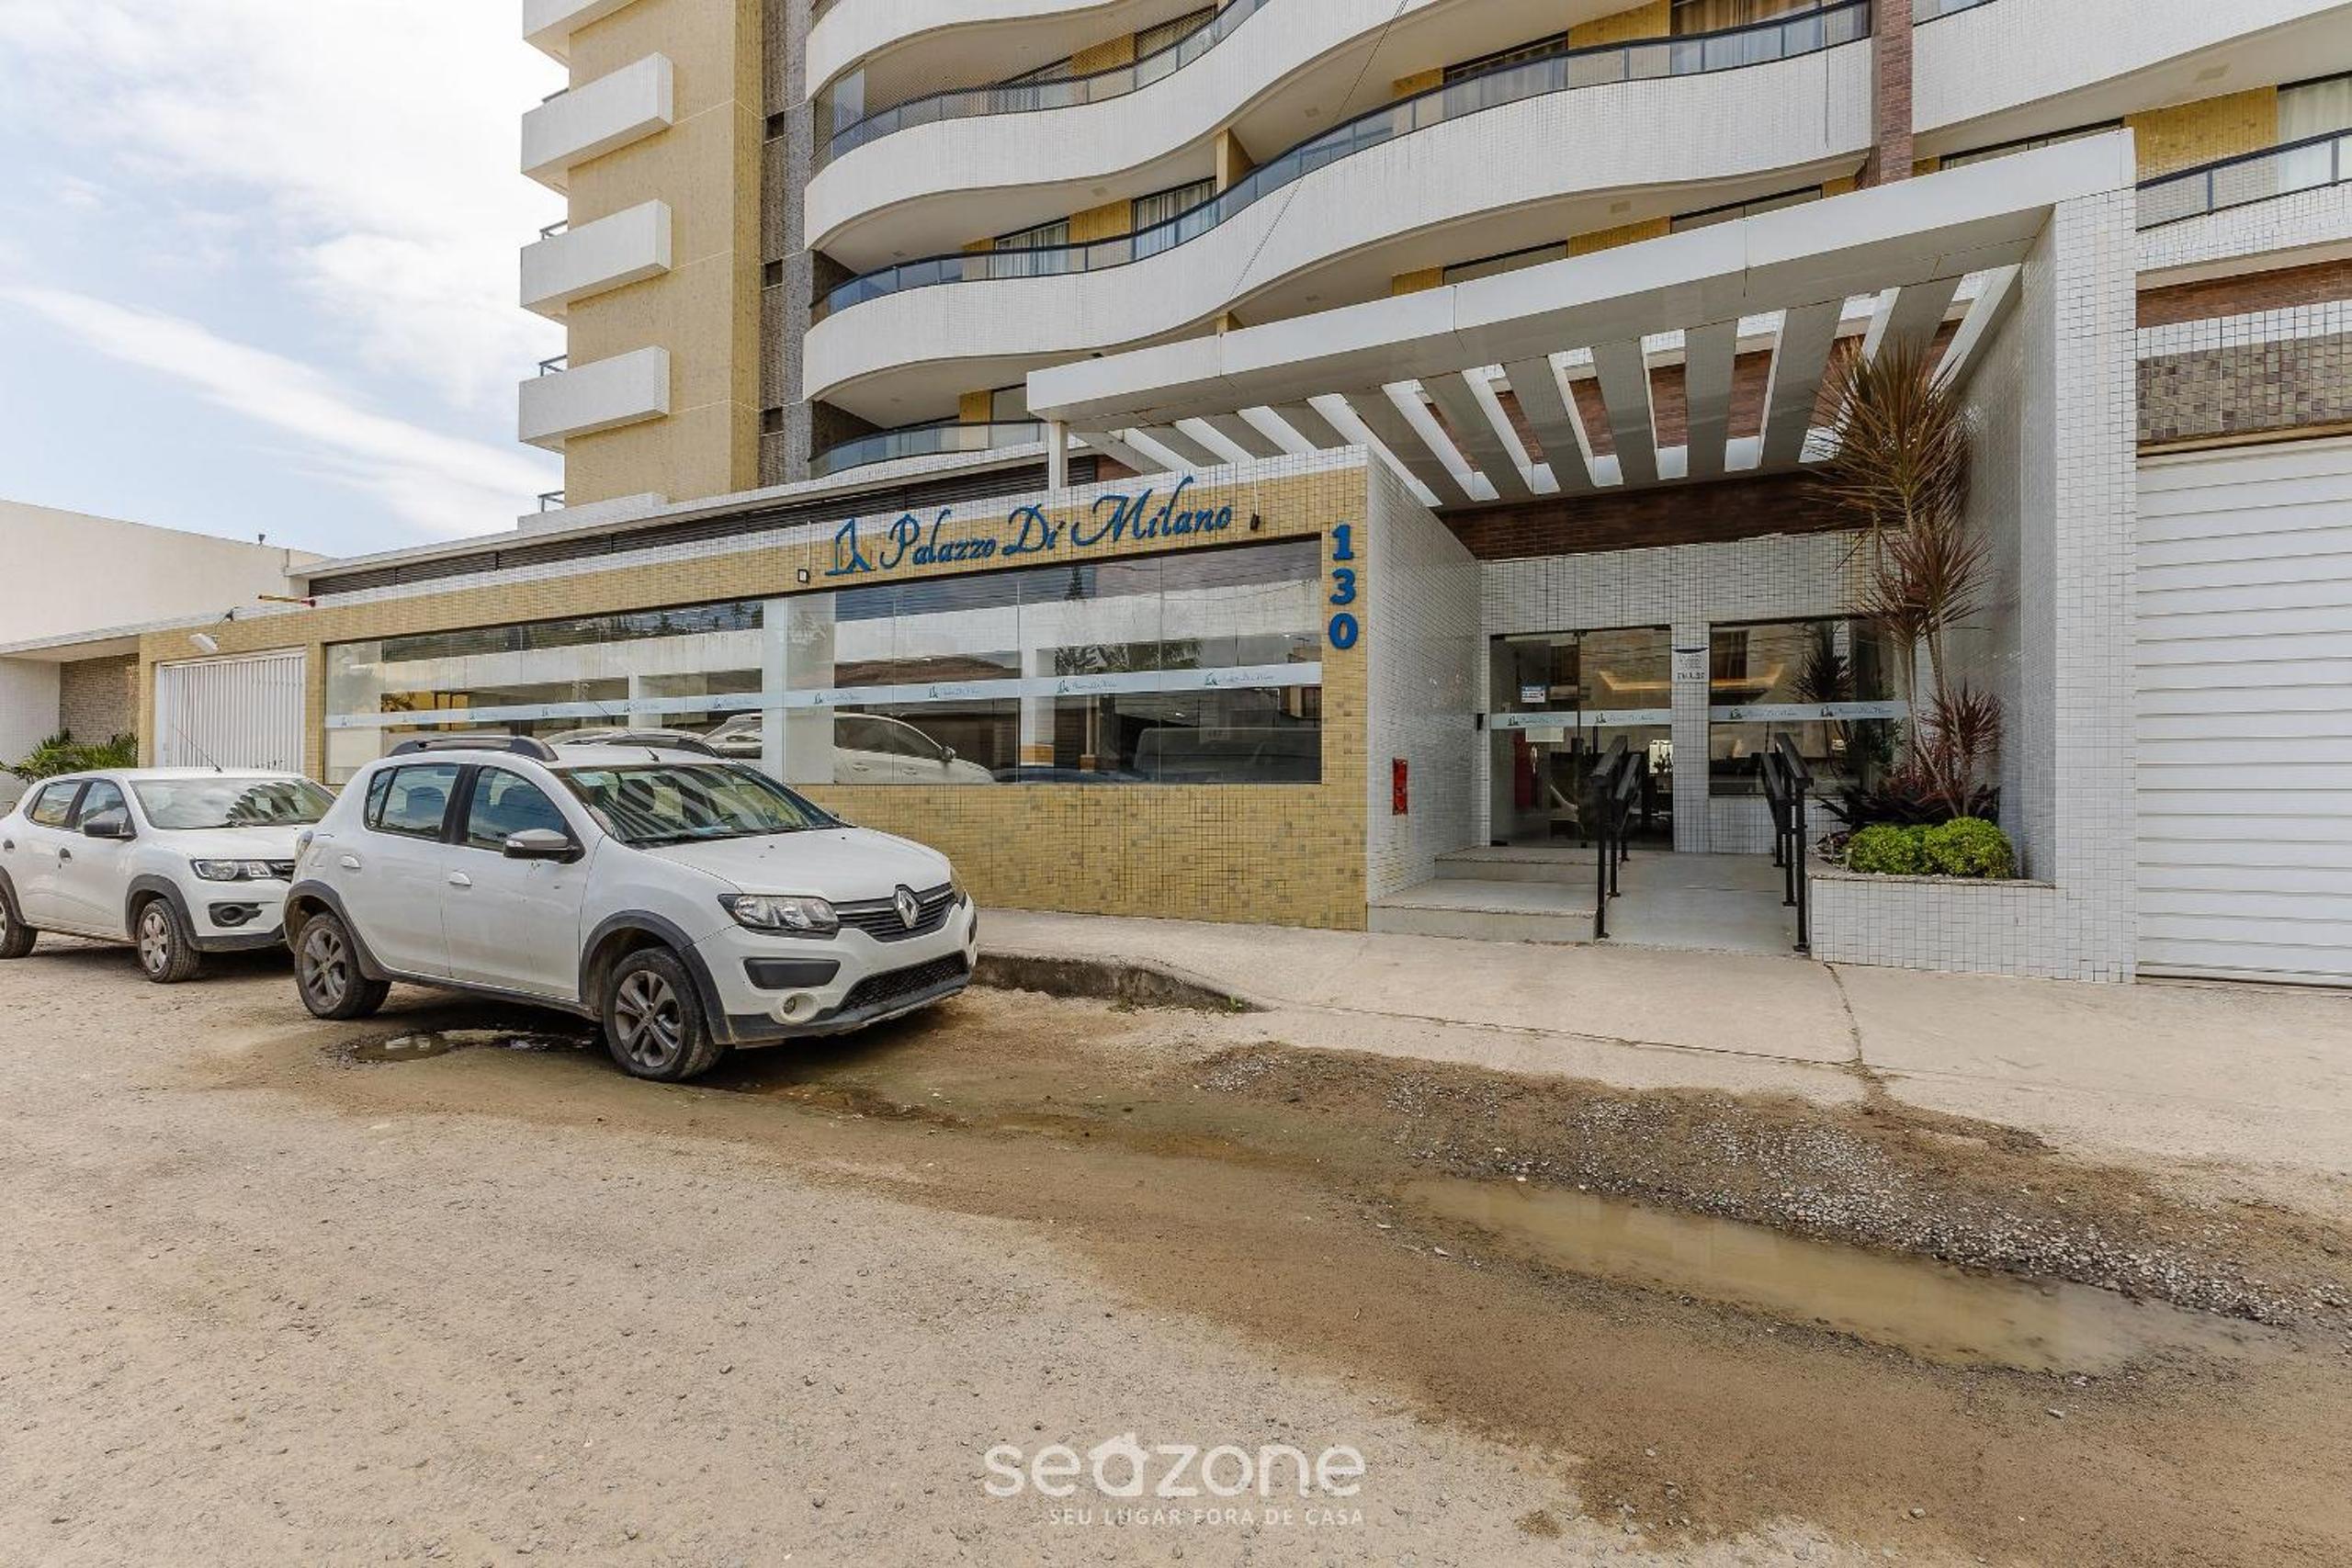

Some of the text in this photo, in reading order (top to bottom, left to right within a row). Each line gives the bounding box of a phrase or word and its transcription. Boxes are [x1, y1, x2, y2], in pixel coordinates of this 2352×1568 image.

[879, 475, 1231, 570] Palazzo Di Milano
[1329, 524, 1359, 650] 130
